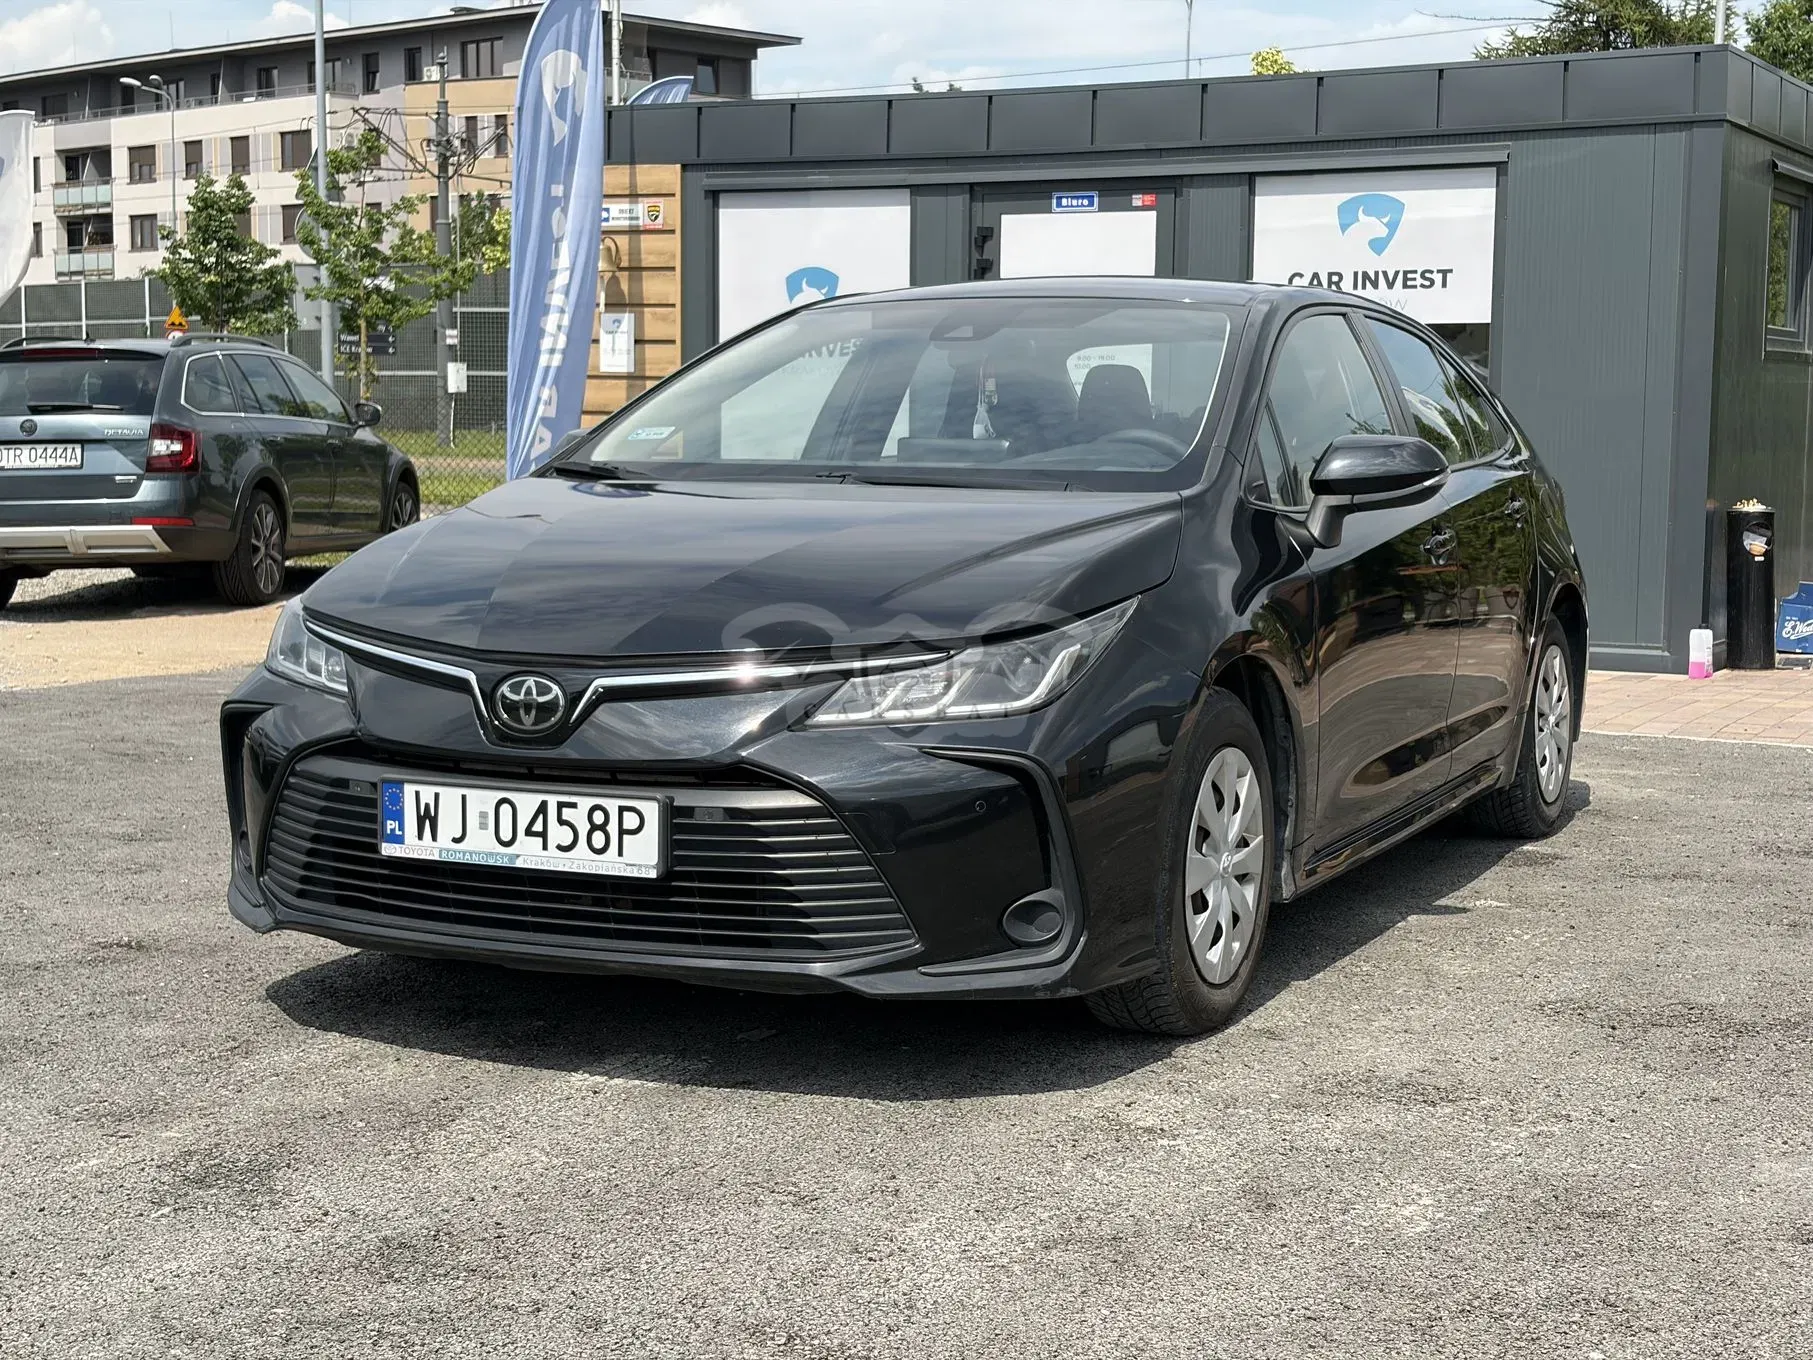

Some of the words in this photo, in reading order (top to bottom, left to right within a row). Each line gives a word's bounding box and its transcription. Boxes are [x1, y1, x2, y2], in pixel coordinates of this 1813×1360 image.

[1287, 271, 1344, 291] CAR
[1352, 268, 1454, 291] INVEST
[0, 447, 23, 464] TR
[28, 446, 79, 464] 0444A
[386, 819, 403, 835] PL
[414, 789, 468, 844] WJ
[494, 796, 646, 858] 0458P
[398, 846, 436, 858] TOYOTA
